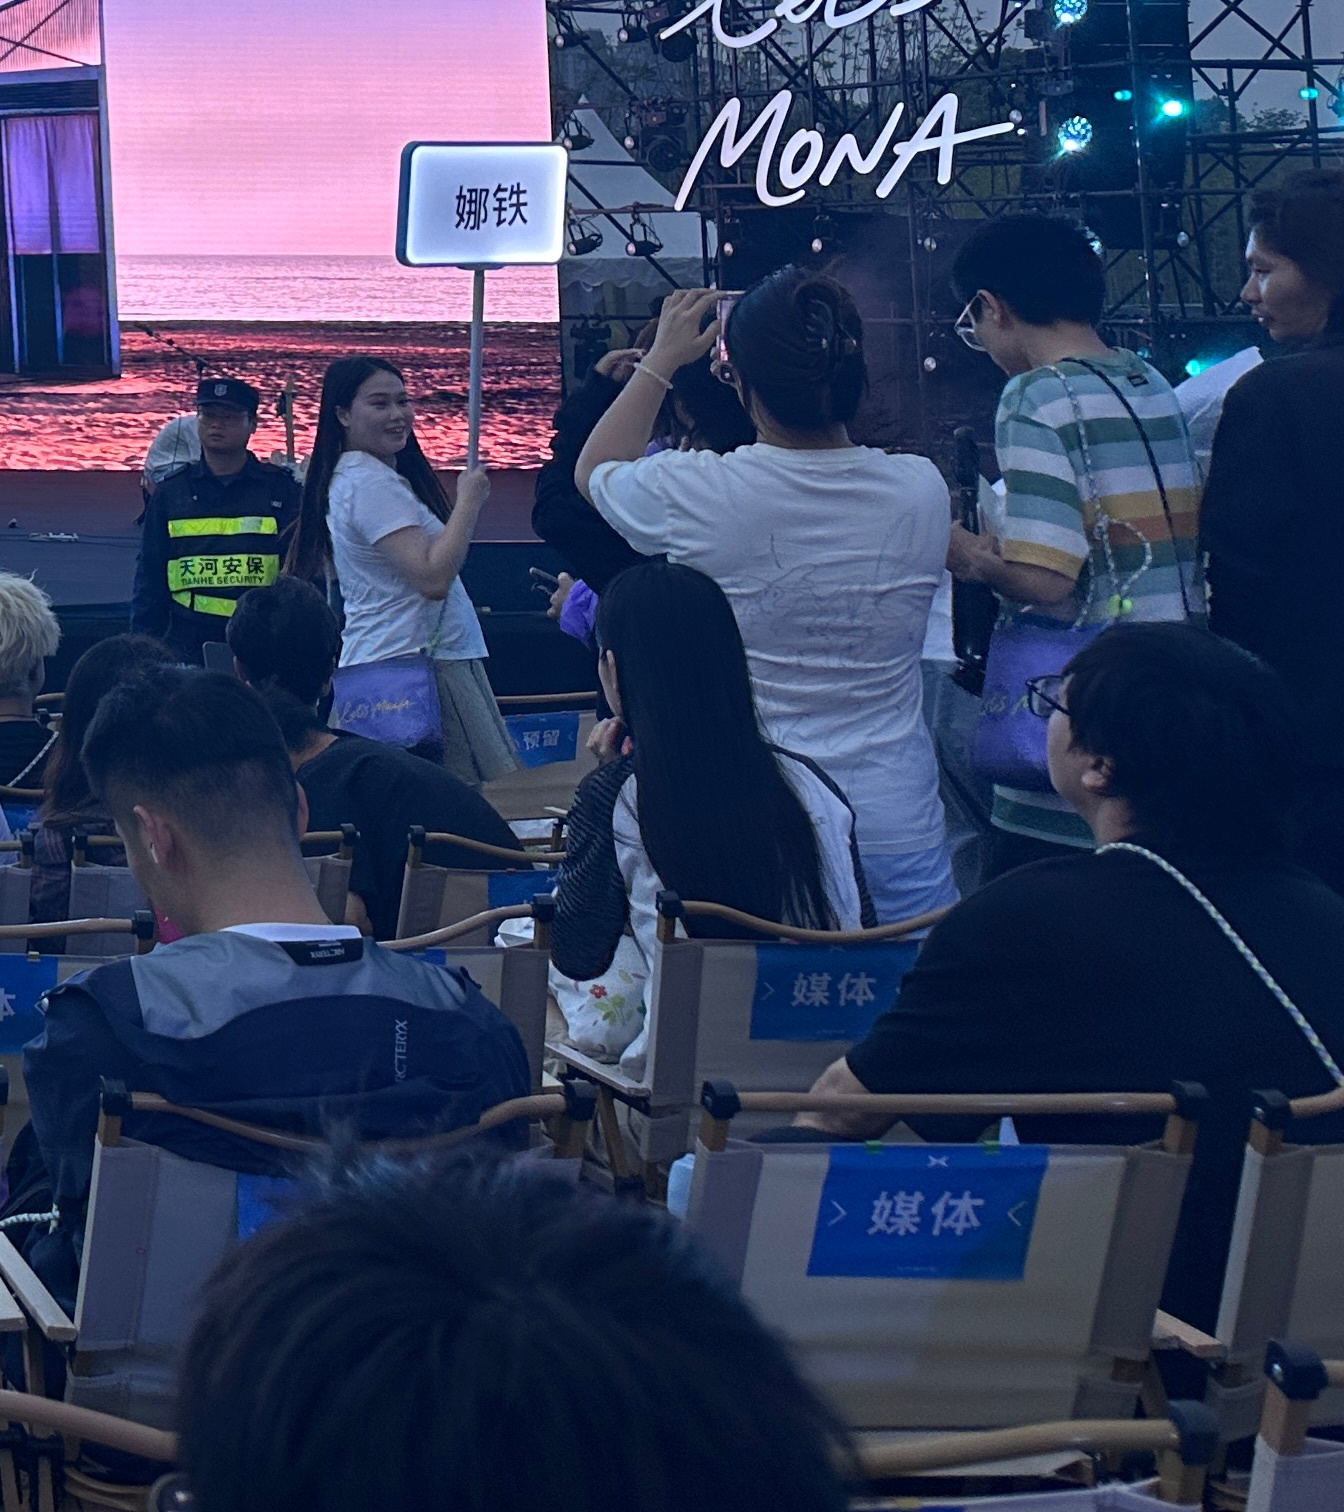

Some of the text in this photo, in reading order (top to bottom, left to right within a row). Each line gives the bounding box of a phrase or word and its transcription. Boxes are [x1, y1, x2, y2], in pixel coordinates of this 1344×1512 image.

[673, 89, 1015, 211] MONA
[454, 182, 529, 233] 娜铁
[180, 556, 264, 576] 天河安保
[216, 575, 264, 584] SECURITY
[523, 729, 560, 750] 预留
[791, 972, 877, 1007] 媒体
[867, 1190, 986, 1237] 媒体
